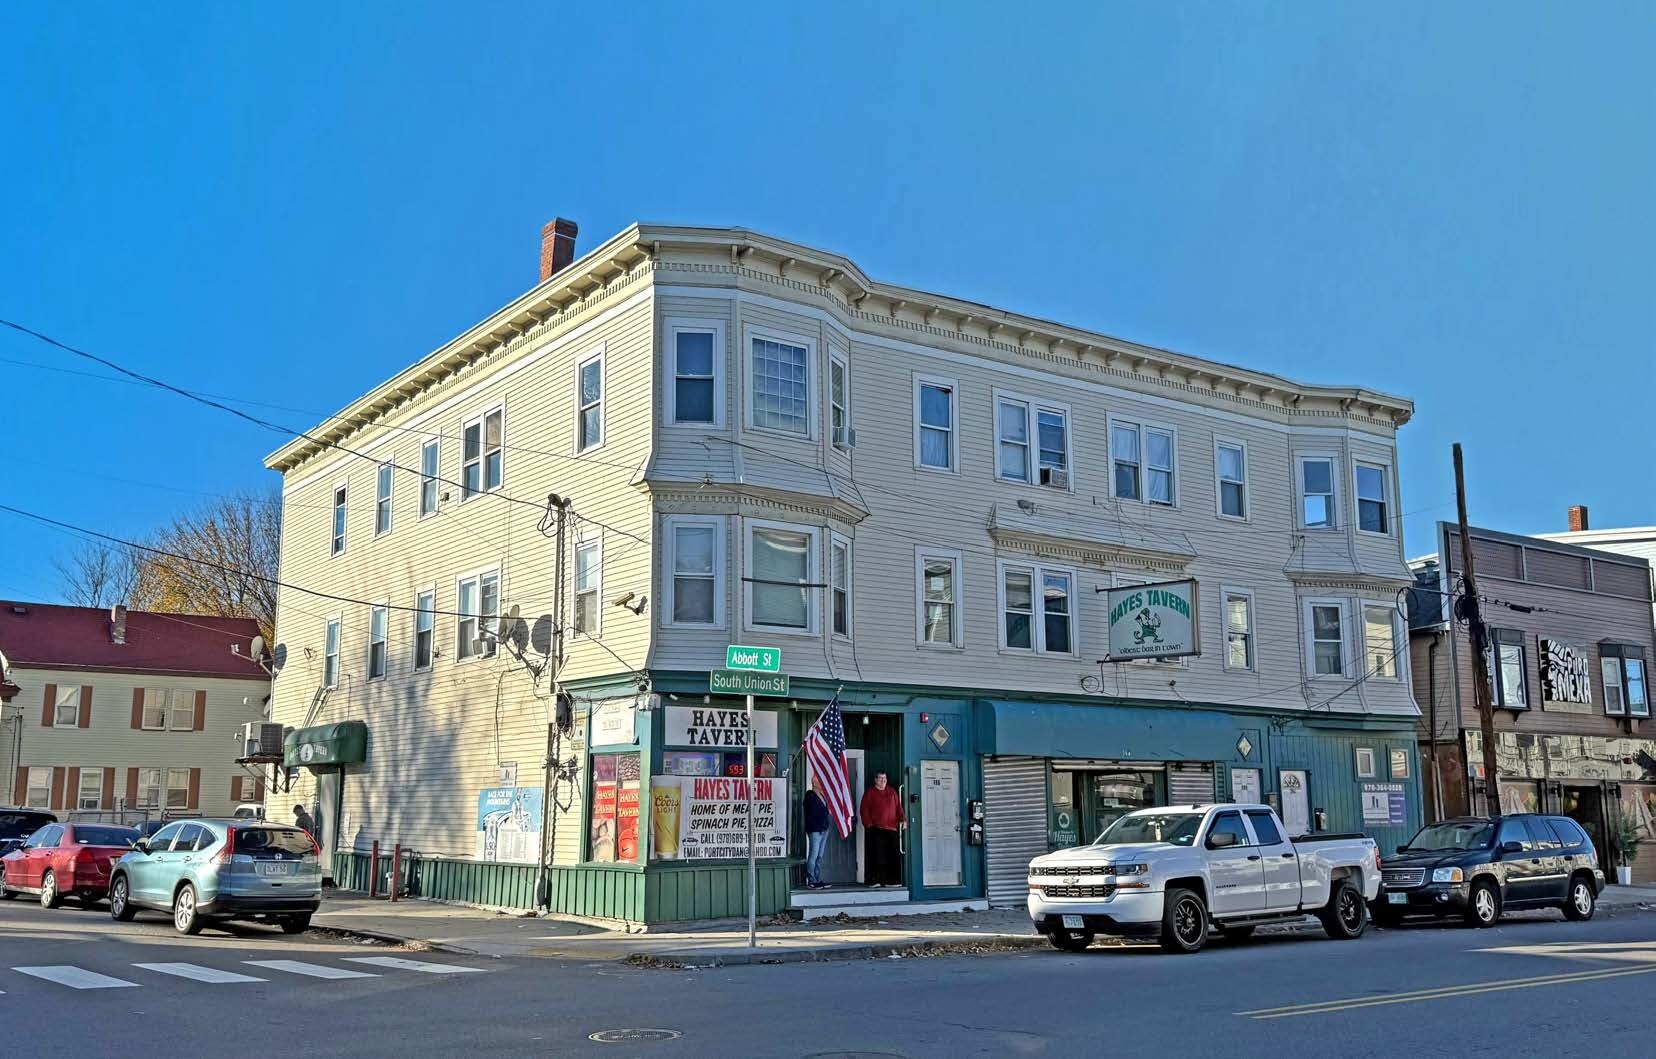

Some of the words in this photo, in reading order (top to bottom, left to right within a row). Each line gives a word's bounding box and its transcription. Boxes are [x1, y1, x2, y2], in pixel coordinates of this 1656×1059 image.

[1110, 591, 1143, 628] HAYES
[1146, 589, 1191, 620] TAVERN
[731, 651, 759, 666] Abbott
[763, 652, 772, 666] St
[1567, 656, 1589, 676] PURO
[714, 674, 742, 688] South
[744, 675, 772, 690] Union
[773, 678, 785, 692] St
[1557, 670, 1592, 704] MEXA
[692, 710, 749, 728] HAYES
[694, 778, 730, 801] HAYES
[732, 778, 772, 801] TAVRN
[655, 795, 679, 807] Coors
[690, 803, 718, 816] HOME
[719, 803, 731, 815] OF
[732, 803, 757, 815] MEA
[758, 802, 774, 816] PIE,
[690, 818, 730, 830] SPINACH
[731, 817, 748, 831] PIE,
[700, 833, 715, 845] CALL
[757, 833, 766, 844] OR
[683, 847, 704, 858] EMAIL:
